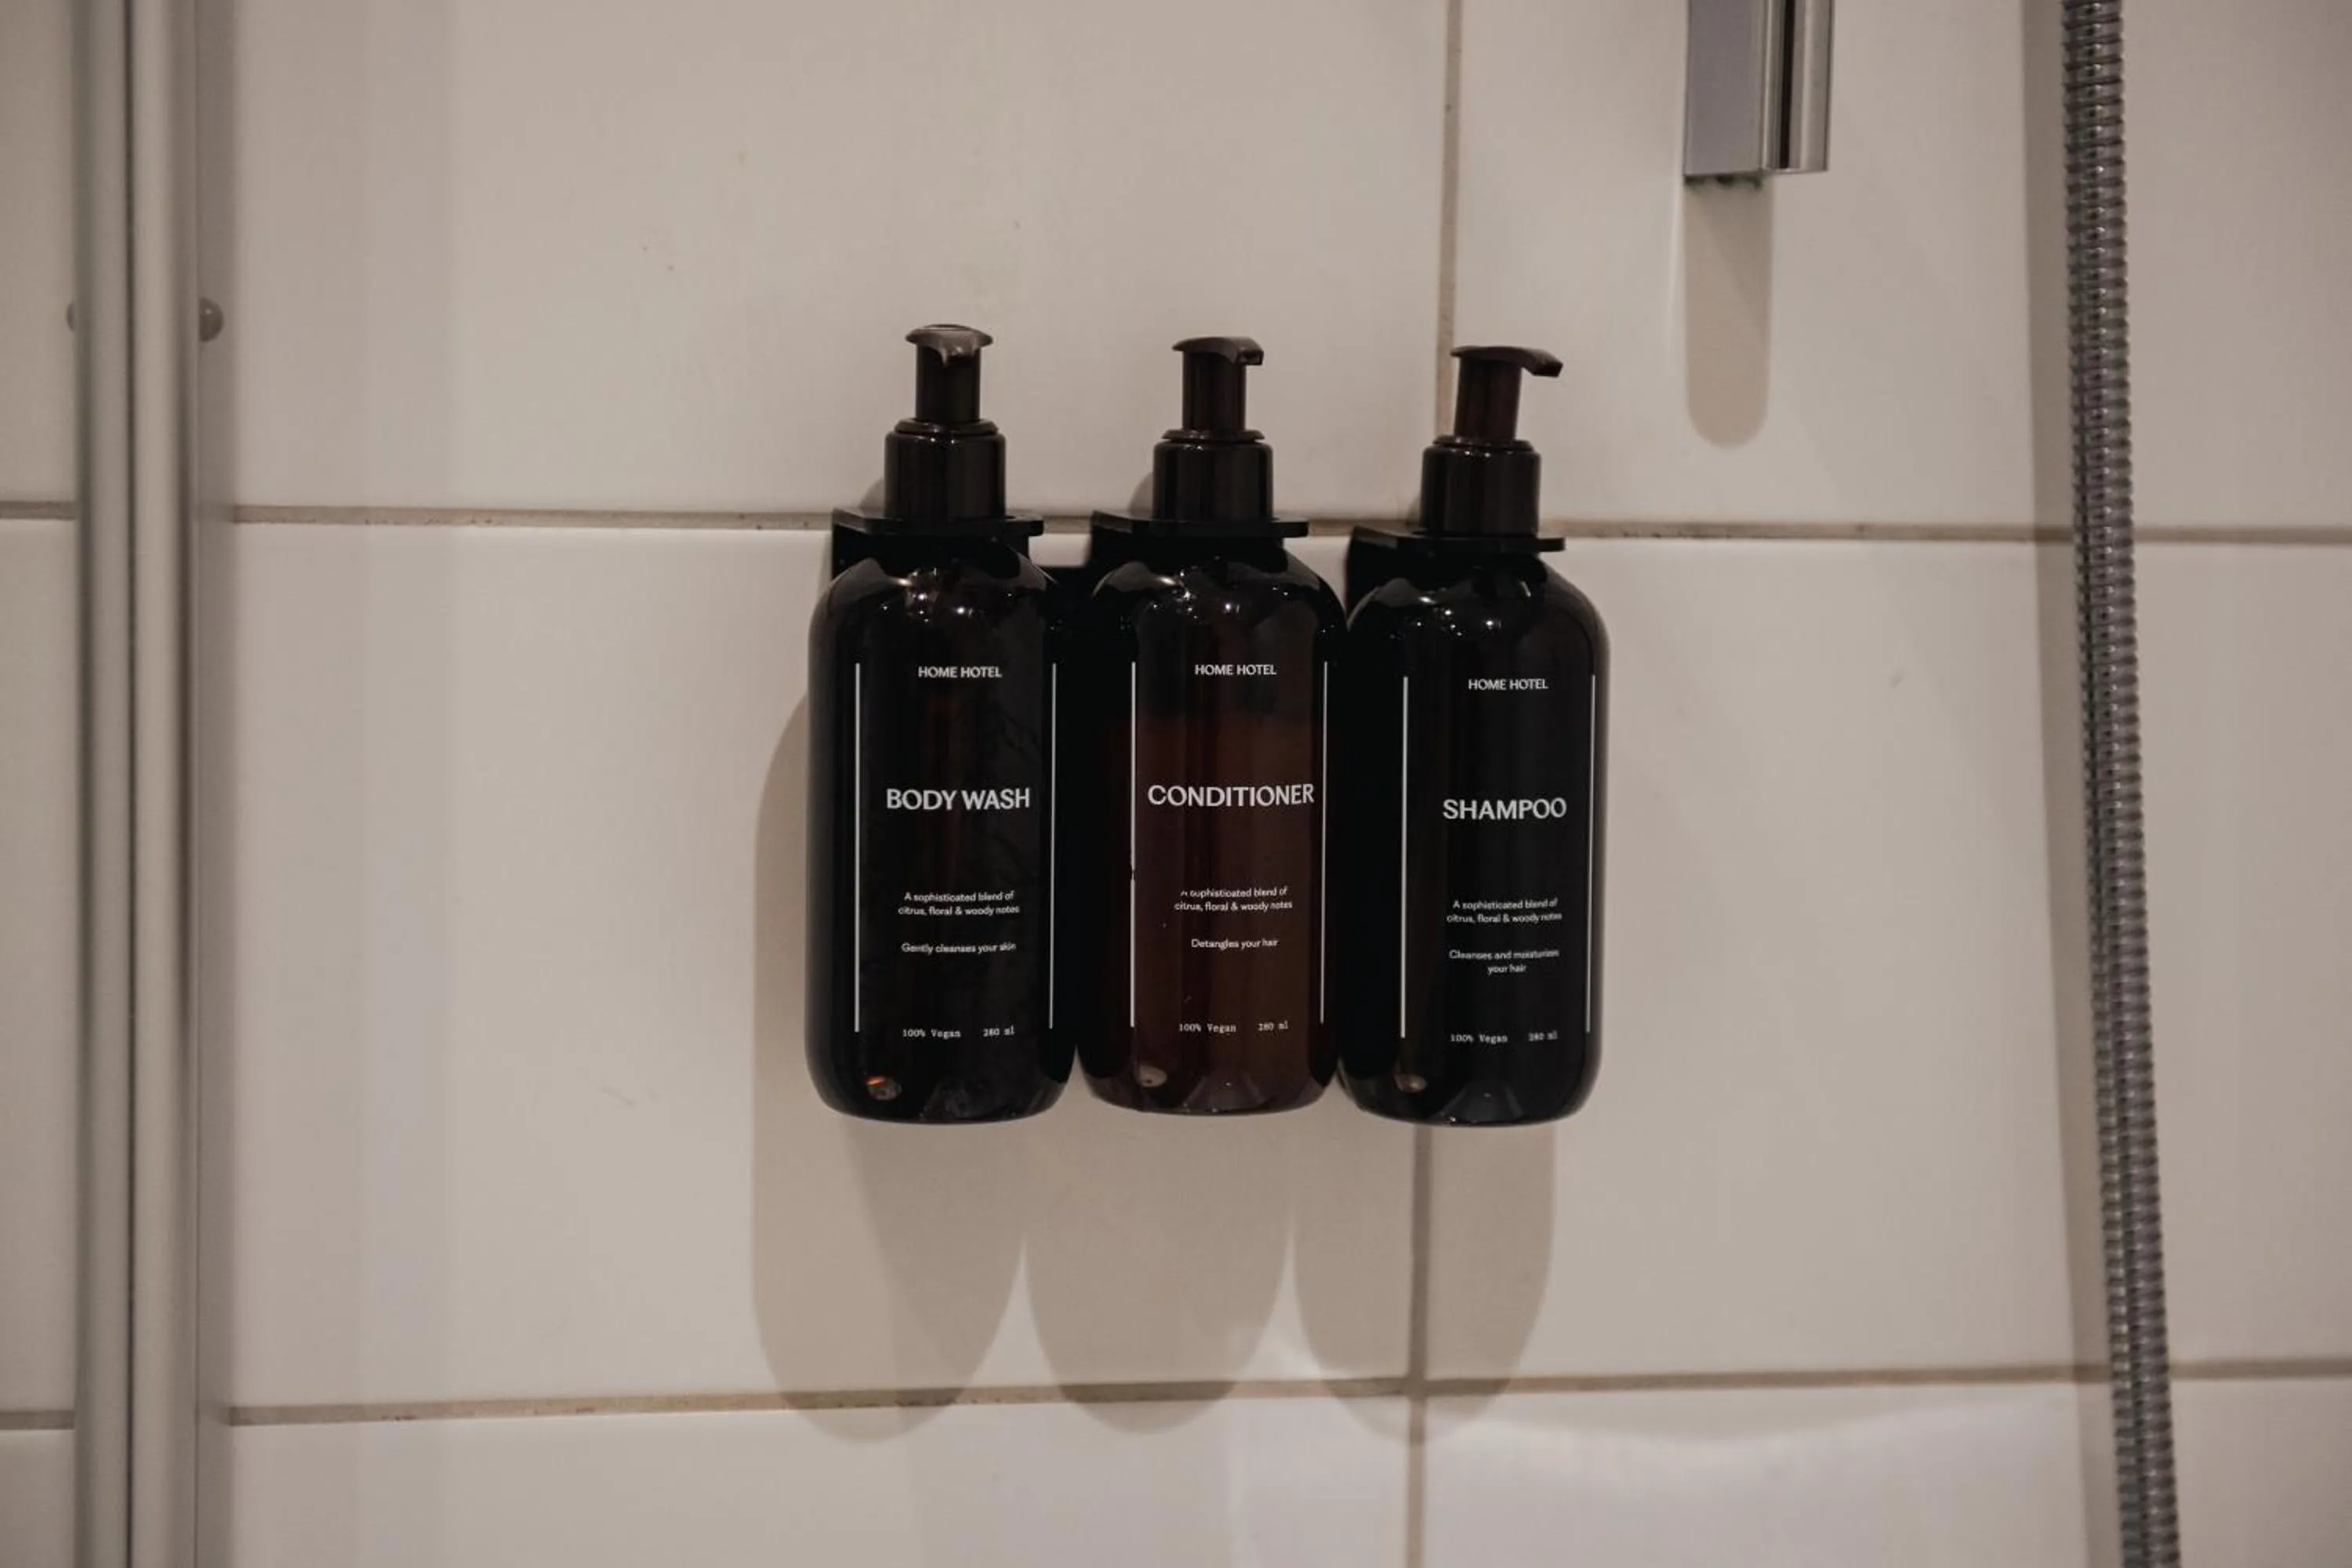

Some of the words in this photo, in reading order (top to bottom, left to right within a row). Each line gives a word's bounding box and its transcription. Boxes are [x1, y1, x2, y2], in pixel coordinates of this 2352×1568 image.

[918, 665, 958, 678] HOME
[960, 665, 1003, 678] HOTEL
[1195, 664, 1233, 676] HOME
[1236, 664, 1277, 676] HOTEL
[1468, 678, 1507, 691] HOME
[1509, 678, 1550, 690] HOTEL
[887, 788, 957, 811] BODY
[960, 787, 1030, 811] WASH
[1148, 783, 1315, 807] CONDITIONER
[1443, 797, 1567, 820] SHAMPOO
[904, 891, 912, 901] A
[913, 892, 976, 903] sophisticated
[978, 891, 1003, 901] blend
[1004, 891, 1015, 900] of
[1254, 887, 1277, 897] blend
[1279, 886, 1288, 895] of
[898, 906, 927, 916] citrus,
[928, 906, 953, 916] floral
[954, 906, 963, 916] &
[964, 906, 994, 916] woody
[995, 905, 1020, 914] notes
[1174, 902, 1203, 912] citrus,
[1205, 902, 1229, 912] floral
[1230, 902, 1239, 912] &
[1240, 902, 1269, 913] woody
[1269, 901, 1293, 909] notes
[1453, 900, 1461, 909] A
[1462, 900, 1523, 911] sophisticated
[1525, 899, 1548, 909] blend
[1548, 898, 1559, 907] of
[1446, 914, 1475, 924] citrus,
[1477, 913, 1501, 923] floral
[1502, 913, 1510, 923] &
[1512, 913, 1539, 924] woody
[1541, 913, 1563, 921] notes
[901, 942, 933, 955] Gently
[935, 943, 976, 953] cleanses
[978, 944, 998, 954] your
[999, 942, 1017, 952] skin
[1191, 938, 1239, 951] Detangles
[1240, 940, 1261, 950] your
[1261, 938, 1279, 947] hair
[1449, 949, 1493, 960] Cleanses
[1494, 950, 1512, 960] and
[1487, 965, 1508, 975] your
[1509, 964, 1527, 973] hair
[902, 1029, 926, 1037] 100%
[931, 1029, 962, 1040] Vegan
[1004, 1025, 1015, 1036] ml
[1179, 1023, 1202, 1032] 100%
[1207, 1023, 1236, 1034] Vegan
[1279, 1020, 1289, 1030] ml
[1479, 1034, 1508, 1045] Vegan
